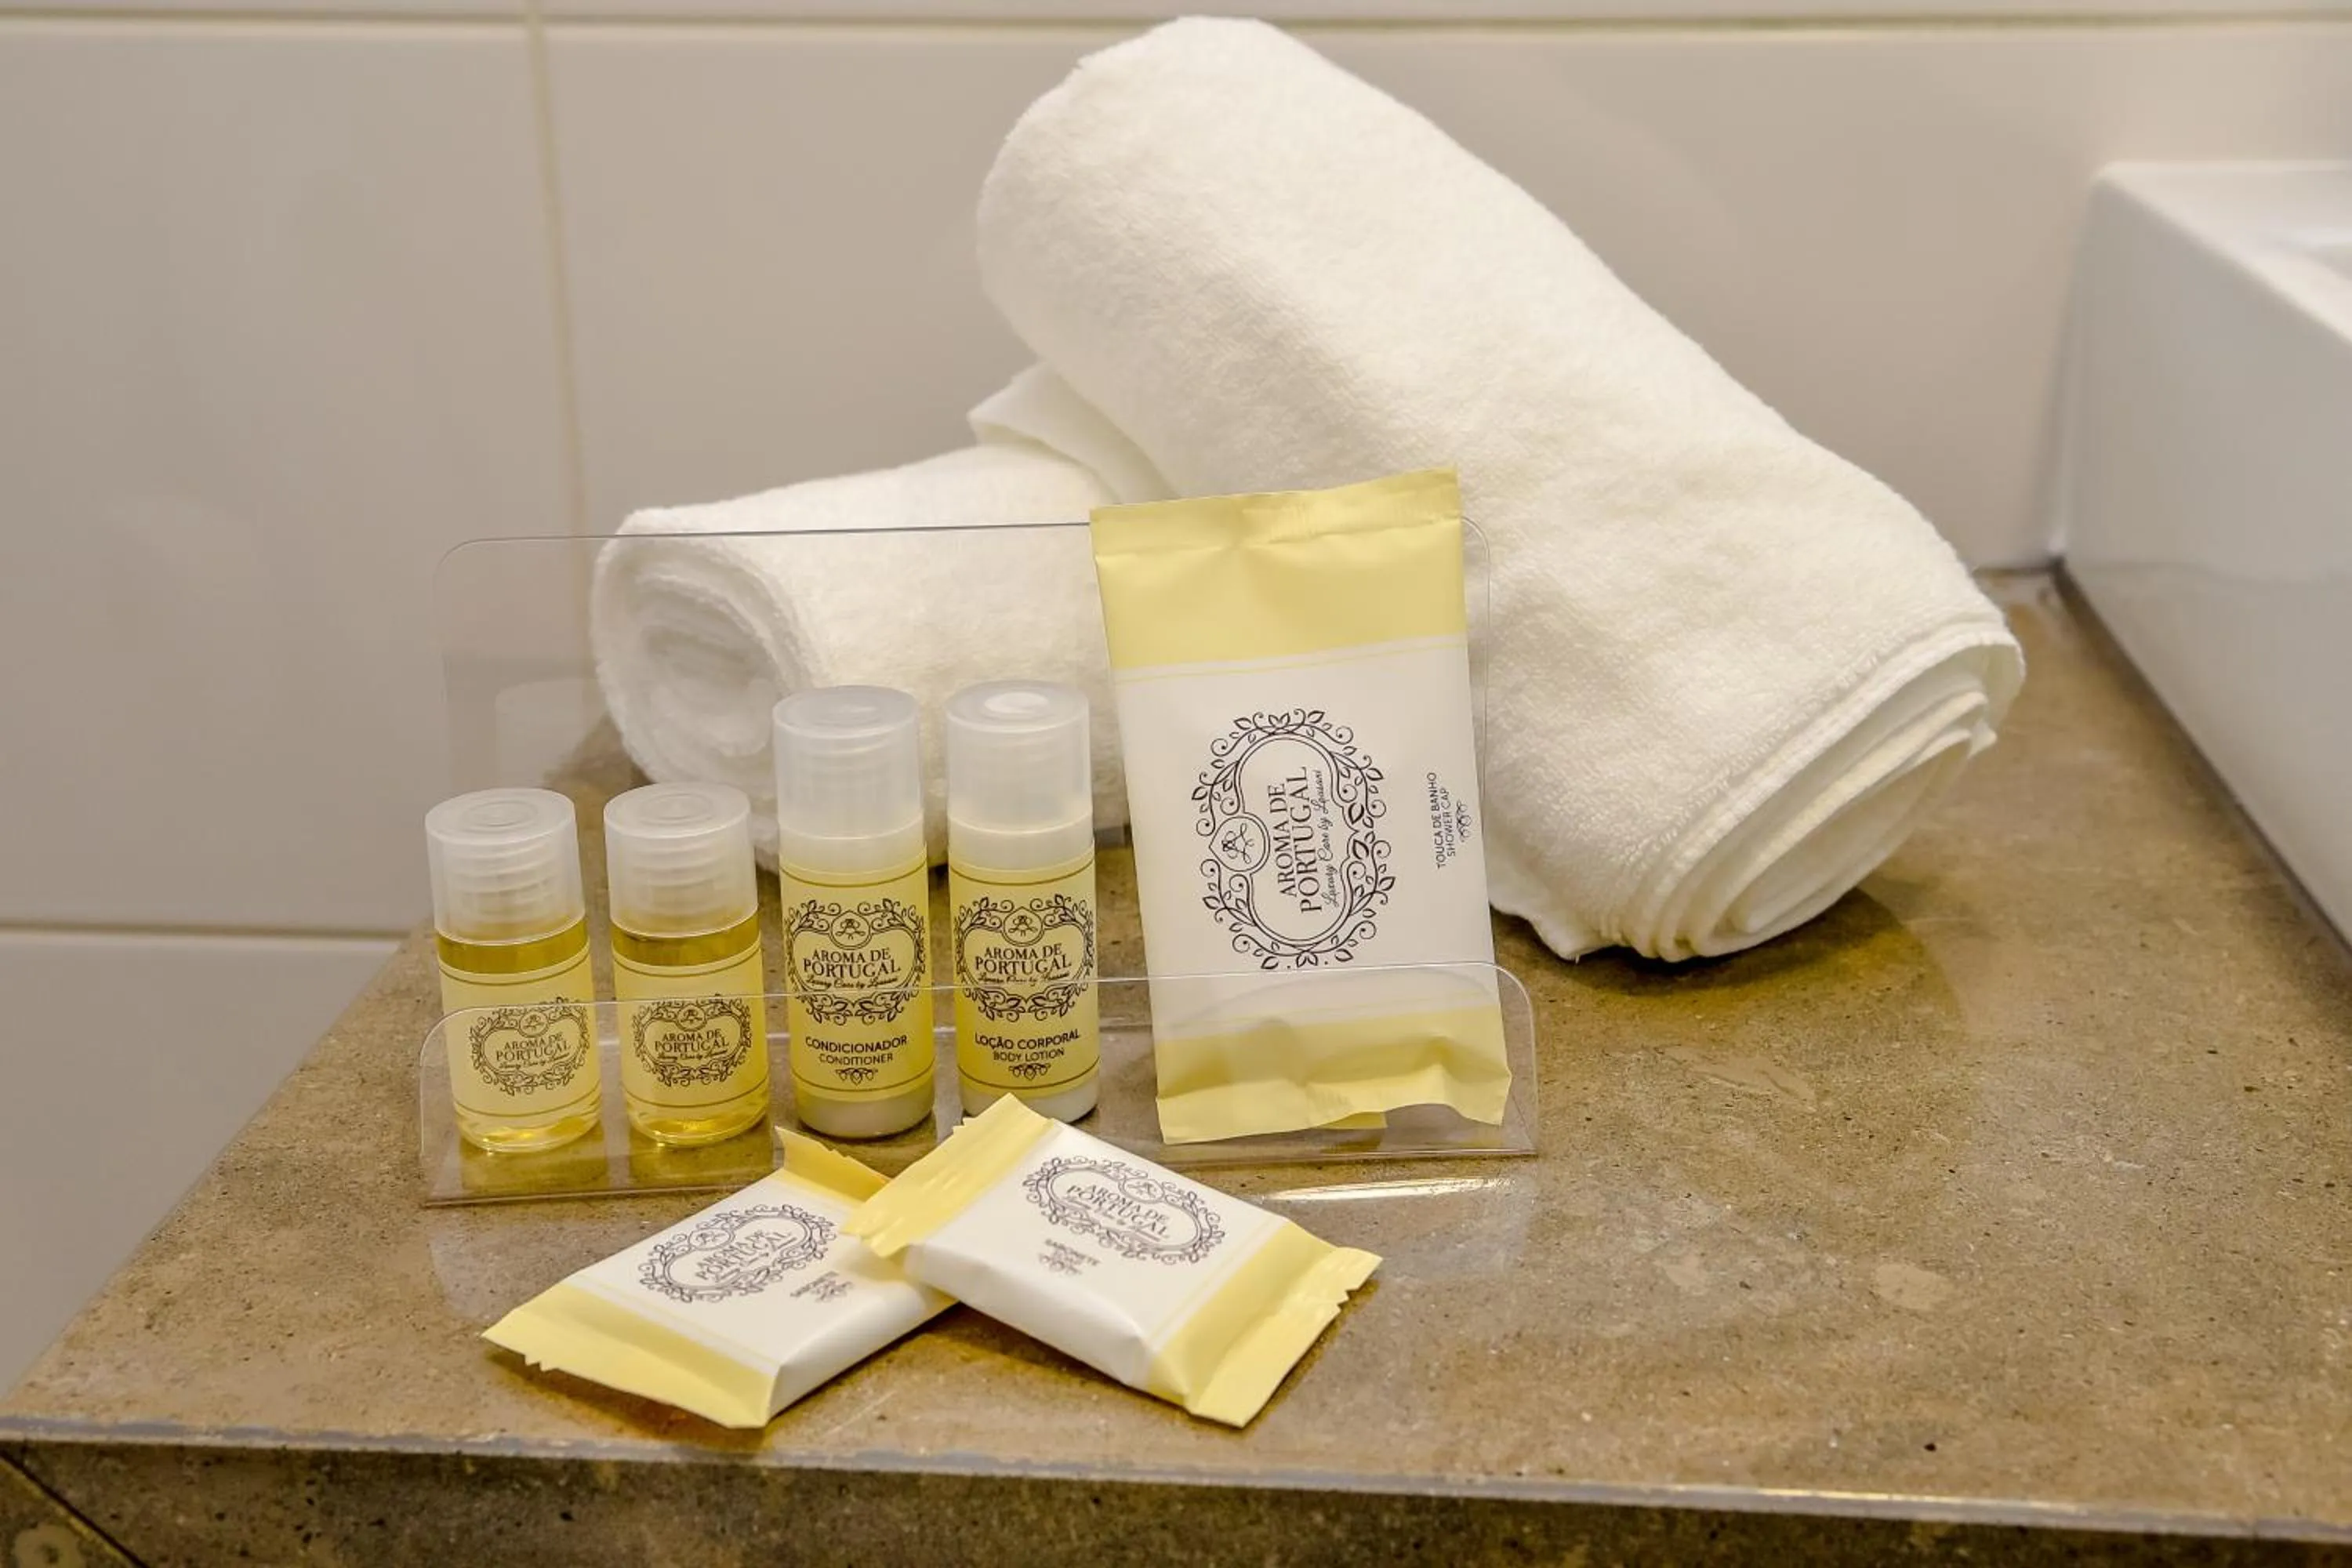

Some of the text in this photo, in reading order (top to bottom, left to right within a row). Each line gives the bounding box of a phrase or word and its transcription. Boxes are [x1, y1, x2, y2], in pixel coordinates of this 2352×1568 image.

[1317, 817, 1333, 829] by
[1427, 772, 1446, 869] TOUCA DE BANHO
[1439, 787, 1456, 857] SHOWER CAP
[1268, 783, 1297, 897] AROMA DE
[1286, 766, 1322, 914] PORTUGAL
[812, 947, 891, 963] AROMA DE
[985, 943, 1062, 960] AROMA DE
[803, 957, 901, 978] PORTUGAL
[975, 954, 1072, 975] PORTUGAL
[504, 1037, 545, 1050] AROMA
[655, 1036, 729, 1052] PORTUGAL
[662, 1029, 721, 1043] AROMA DE
[805, 1035, 907, 1053] CONDICIONADOR
[975, 1029, 1080, 1049] LOÇÃO CORPORAL
[496, 1040, 571, 1061] PORTUGAL
[819, 1053, 893, 1065] CONDITIONER
[993, 1047, 1064, 1062] BODY LOTION
